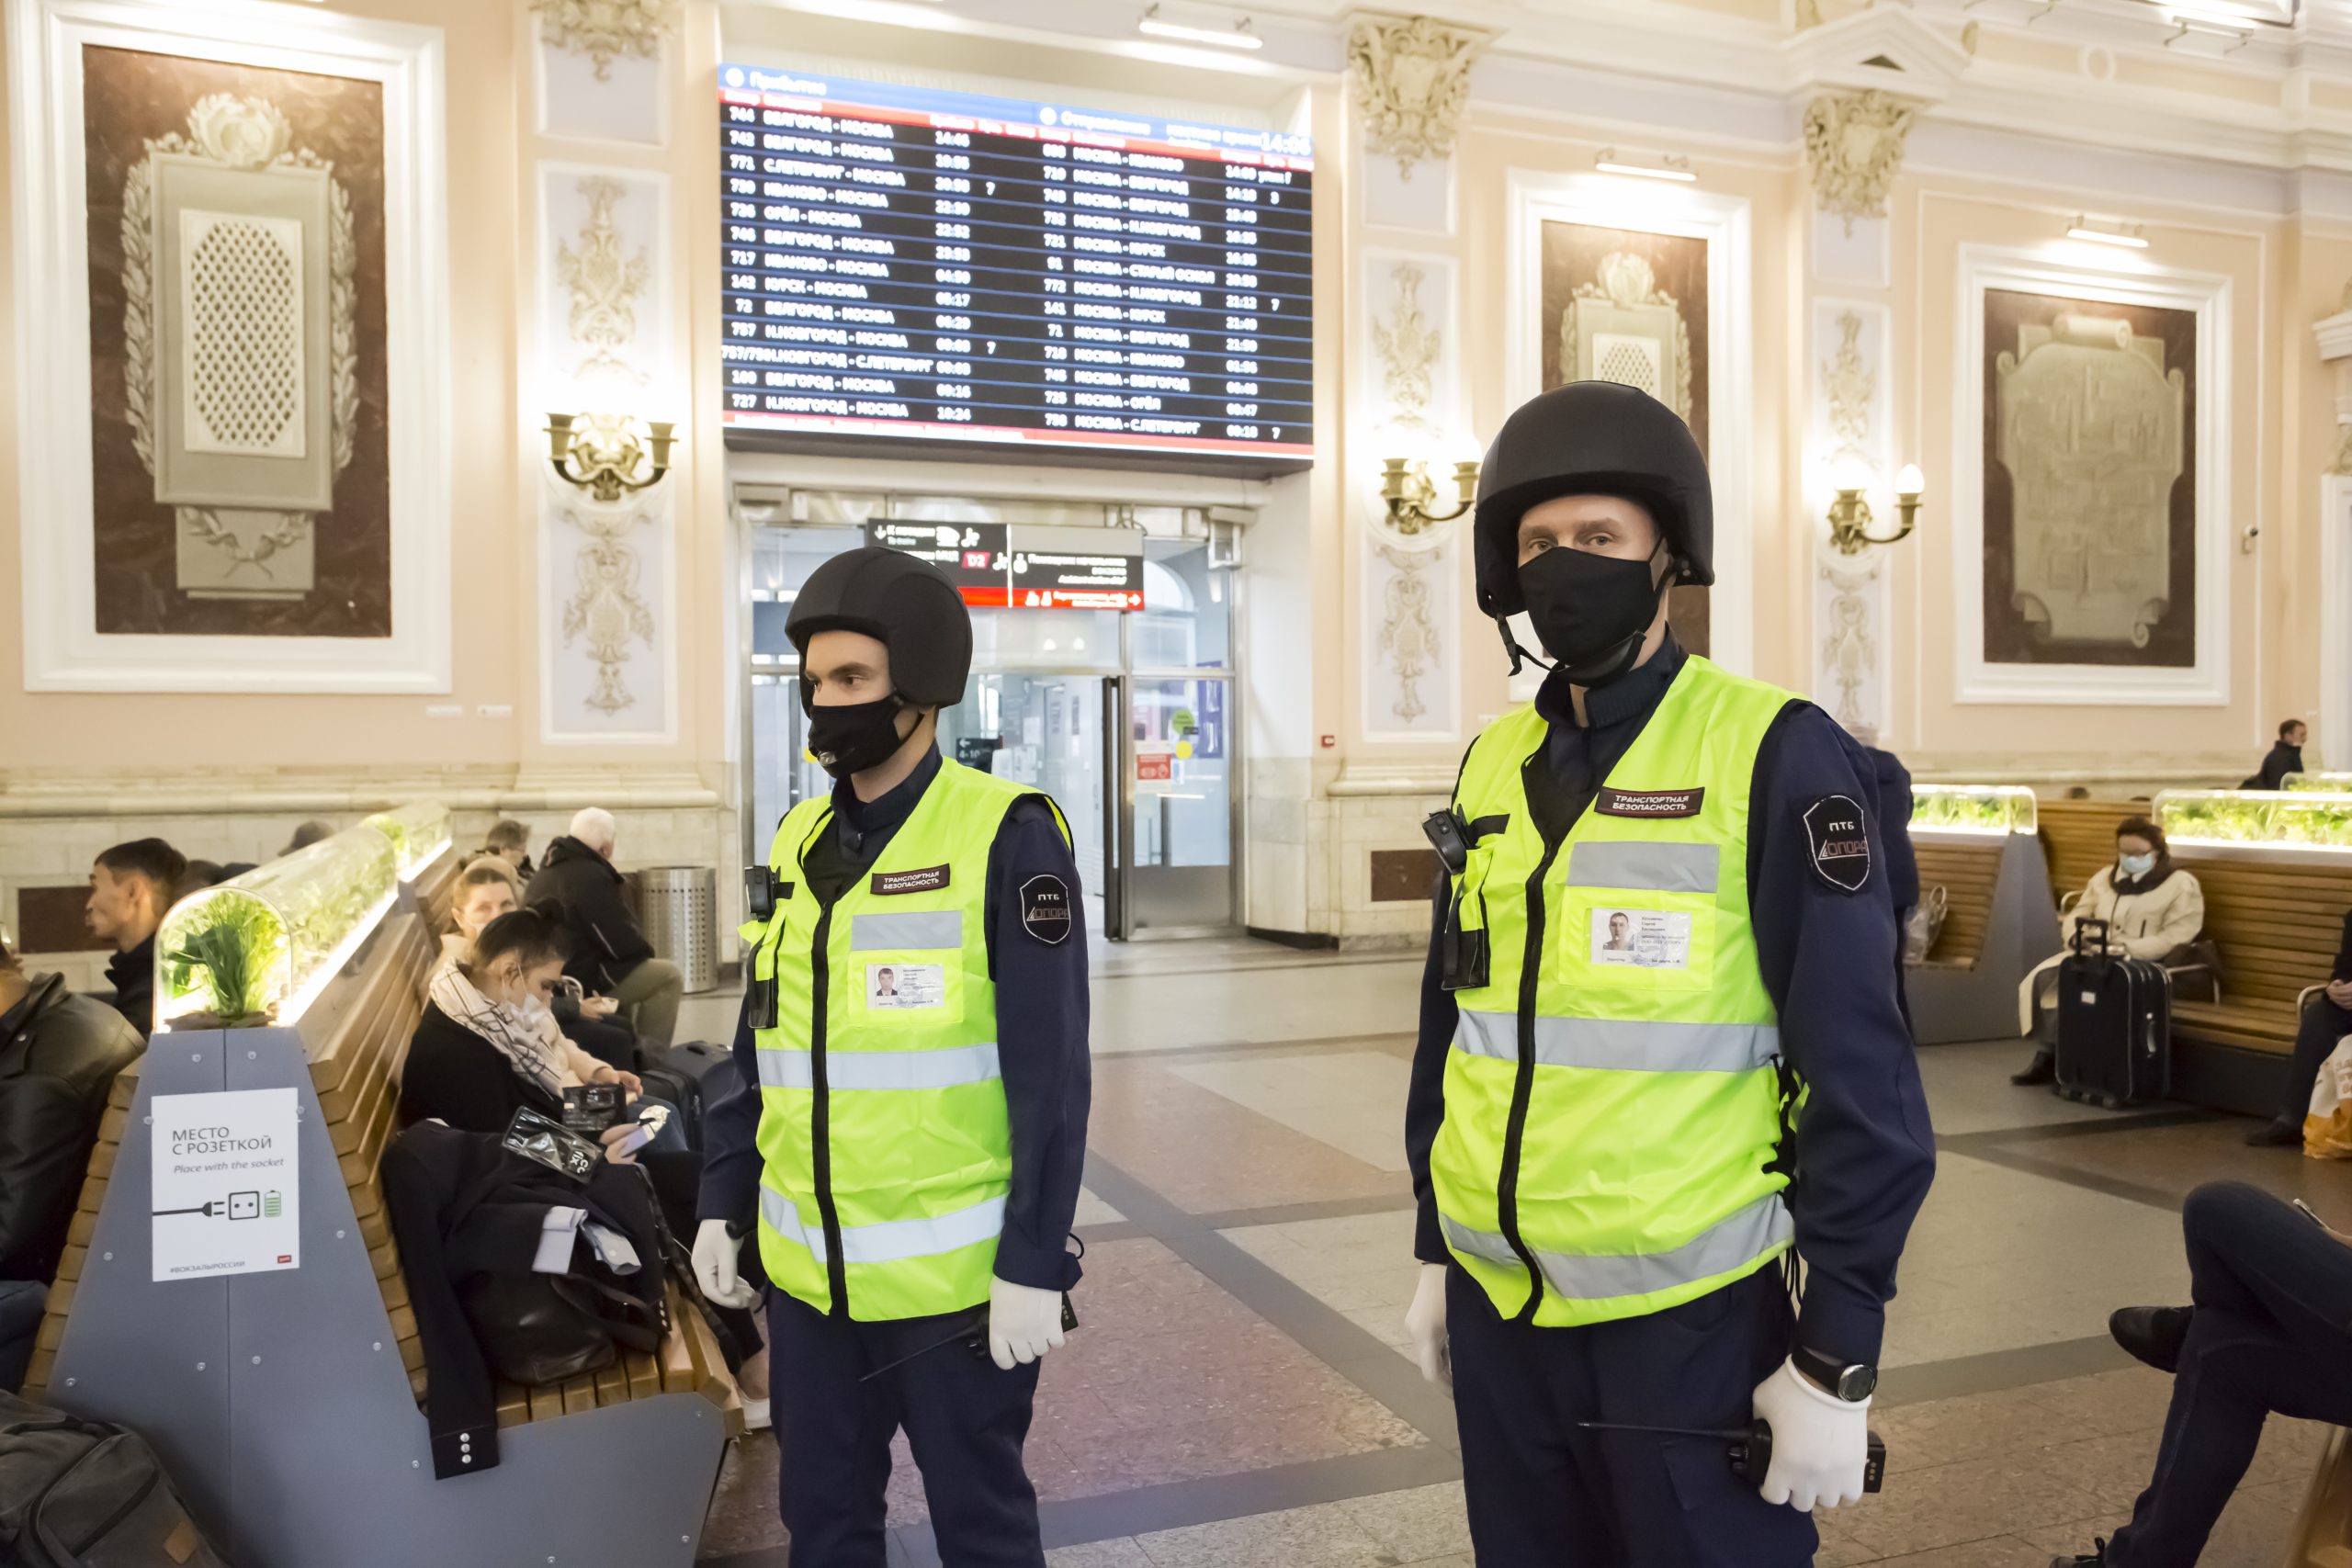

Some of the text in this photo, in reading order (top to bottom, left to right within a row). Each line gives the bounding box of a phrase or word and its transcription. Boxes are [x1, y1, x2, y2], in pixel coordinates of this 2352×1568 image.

[841, 119, 893, 138] МОСКВА
[841, 143, 893, 161] МОСКВА
[1073, 147, 1120, 164] МОСКВА
[730, 154, 755, 170] 771
[853, 168, 904, 185] МОСКВА
[1073, 169, 1120, 186] МОСКВА
[835, 189, 888, 207] МОСКВА
[1074, 192, 1121, 208] МОСКВА
[808, 210, 861, 227] МОСКВА
[1074, 214, 1121, 230] МОСКВА
[842, 237, 893, 254] МОСКВА
[1044, 233, 1066, 248] 721
[1074, 237, 1121, 252] МОСКВА
[731, 250, 755, 265] 717
[836, 260, 888, 276] МОСКВА
[1074, 259, 1121, 274] МОСКВА
[731, 275, 755, 289] 142
[815, 281, 866, 299] МОСКВА
[1044, 278, 1066, 293] 772
[1074, 281, 1121, 296] МОСКВА
[1272, 299, 1279, 310] 7
[736, 299, 752, 313] 72
[842, 308, 894, 323] МОСКВА
[1045, 301, 1066, 315] 141
[1074, 304, 1121, 319] МОСКВА
[1048, 324, 1063, 337] 71
[1074, 326, 1121, 341] МОСКВА
[856, 333, 907, 347] МОСКВА
[987, 342, 996, 354] 7
[1075, 348, 1121, 363] МОСКВА
[842, 378, 894, 393] МОСКВА
[1075, 371, 1121, 385] МОСКВА
[732, 394, 756, 408] 727
[856, 403, 908, 417] МОСКВА
[1075, 393, 1121, 407] МОСКВА
[1075, 415, 1121, 429] МОСКВА
[1272, 427, 1280, 439] 7
[967, 554, 986, 567] D2
[1612, 803, 1687, 811] БЕЗОПАСНОСТЬ
[1615, 795, 1690, 804] ТРАНСПОРТНАЯ
[1829, 821, 1855, 831] ПТБ
[883, 878, 939, 890] БЕЗОПАСНОСТЬ
[884, 871, 940, 884] ТРАНСПОРТНАЯ
[172, 1126, 230, 1142] МЕСТО
[172, 1135, 272, 1155] С РОЗЕТКОЙ
[174, 1158, 284, 1174] Place with the socket
[170, 1260, 245, 1273] #ВОКЗАЛЫРОССИИ
